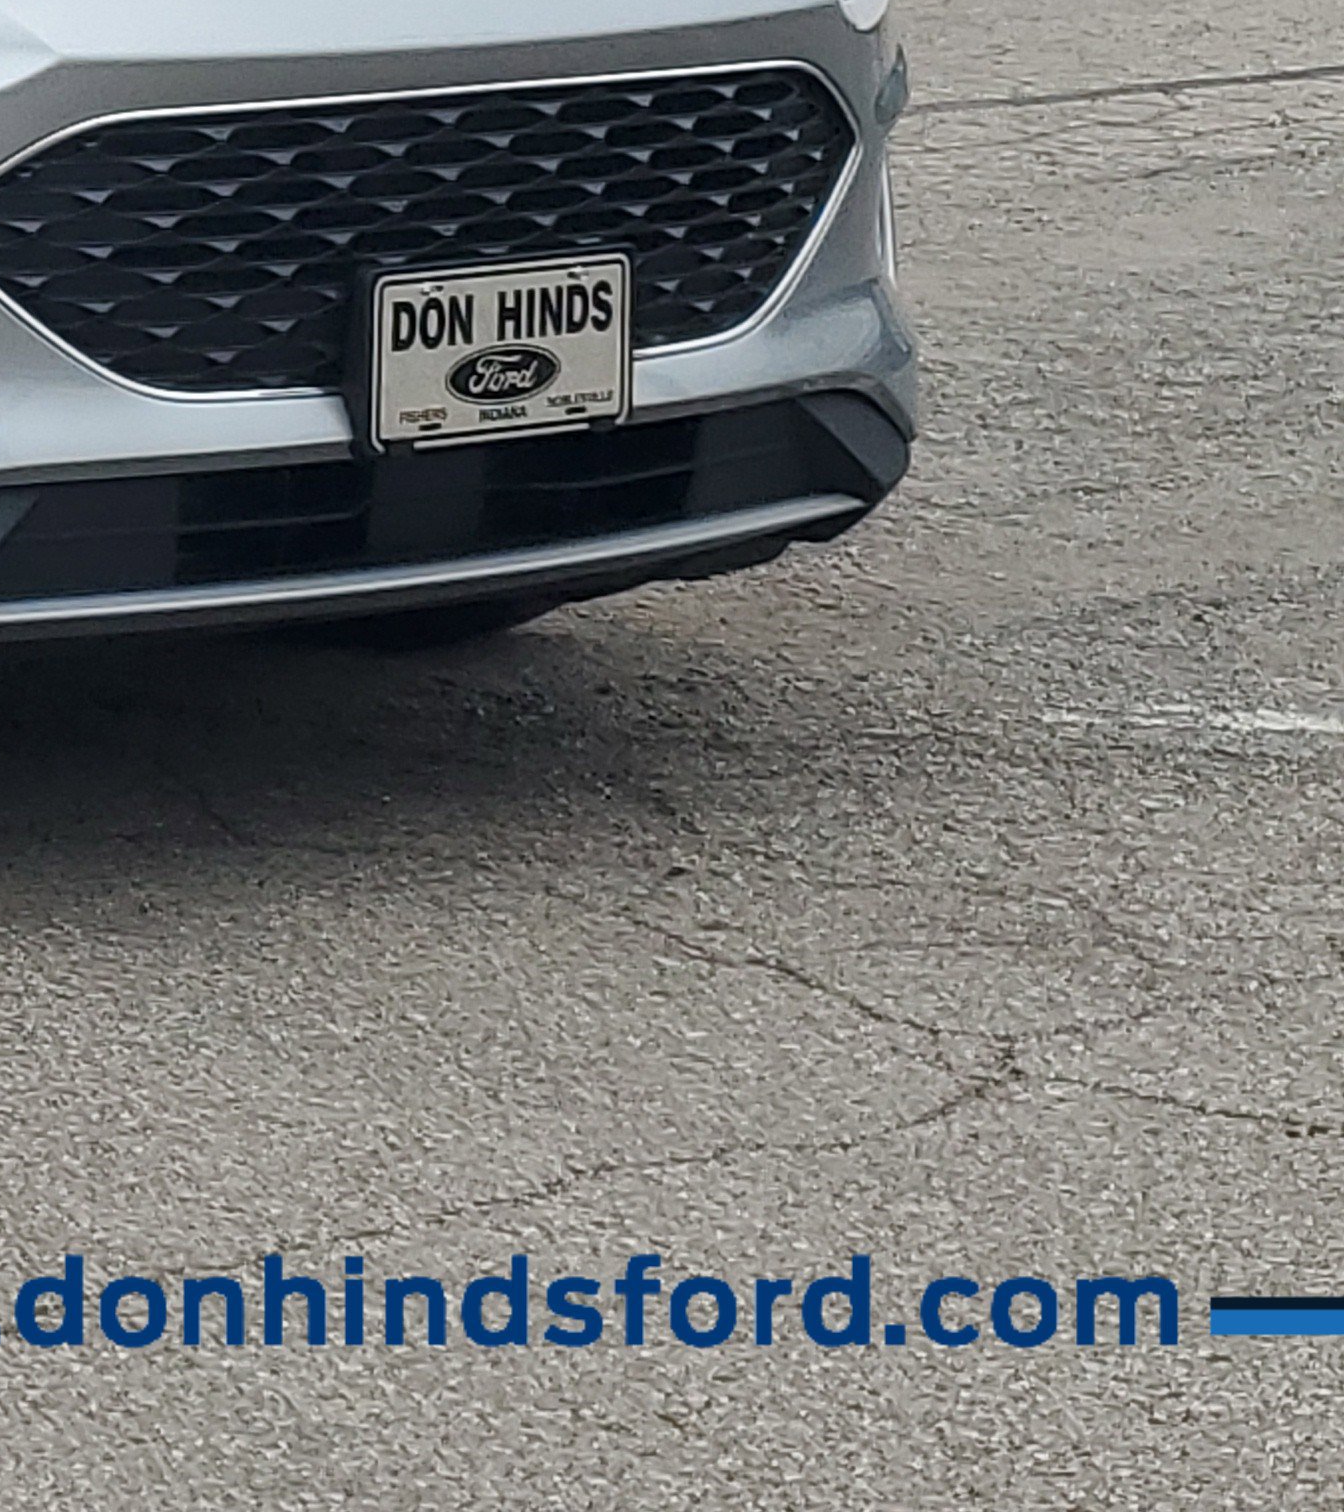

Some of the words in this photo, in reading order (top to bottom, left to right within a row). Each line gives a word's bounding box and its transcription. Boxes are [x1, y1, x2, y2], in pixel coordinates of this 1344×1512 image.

[391, 293, 474, 352] DON
[496, 279, 613, 342] HINDS
[468, 354, 539, 395] Ford
